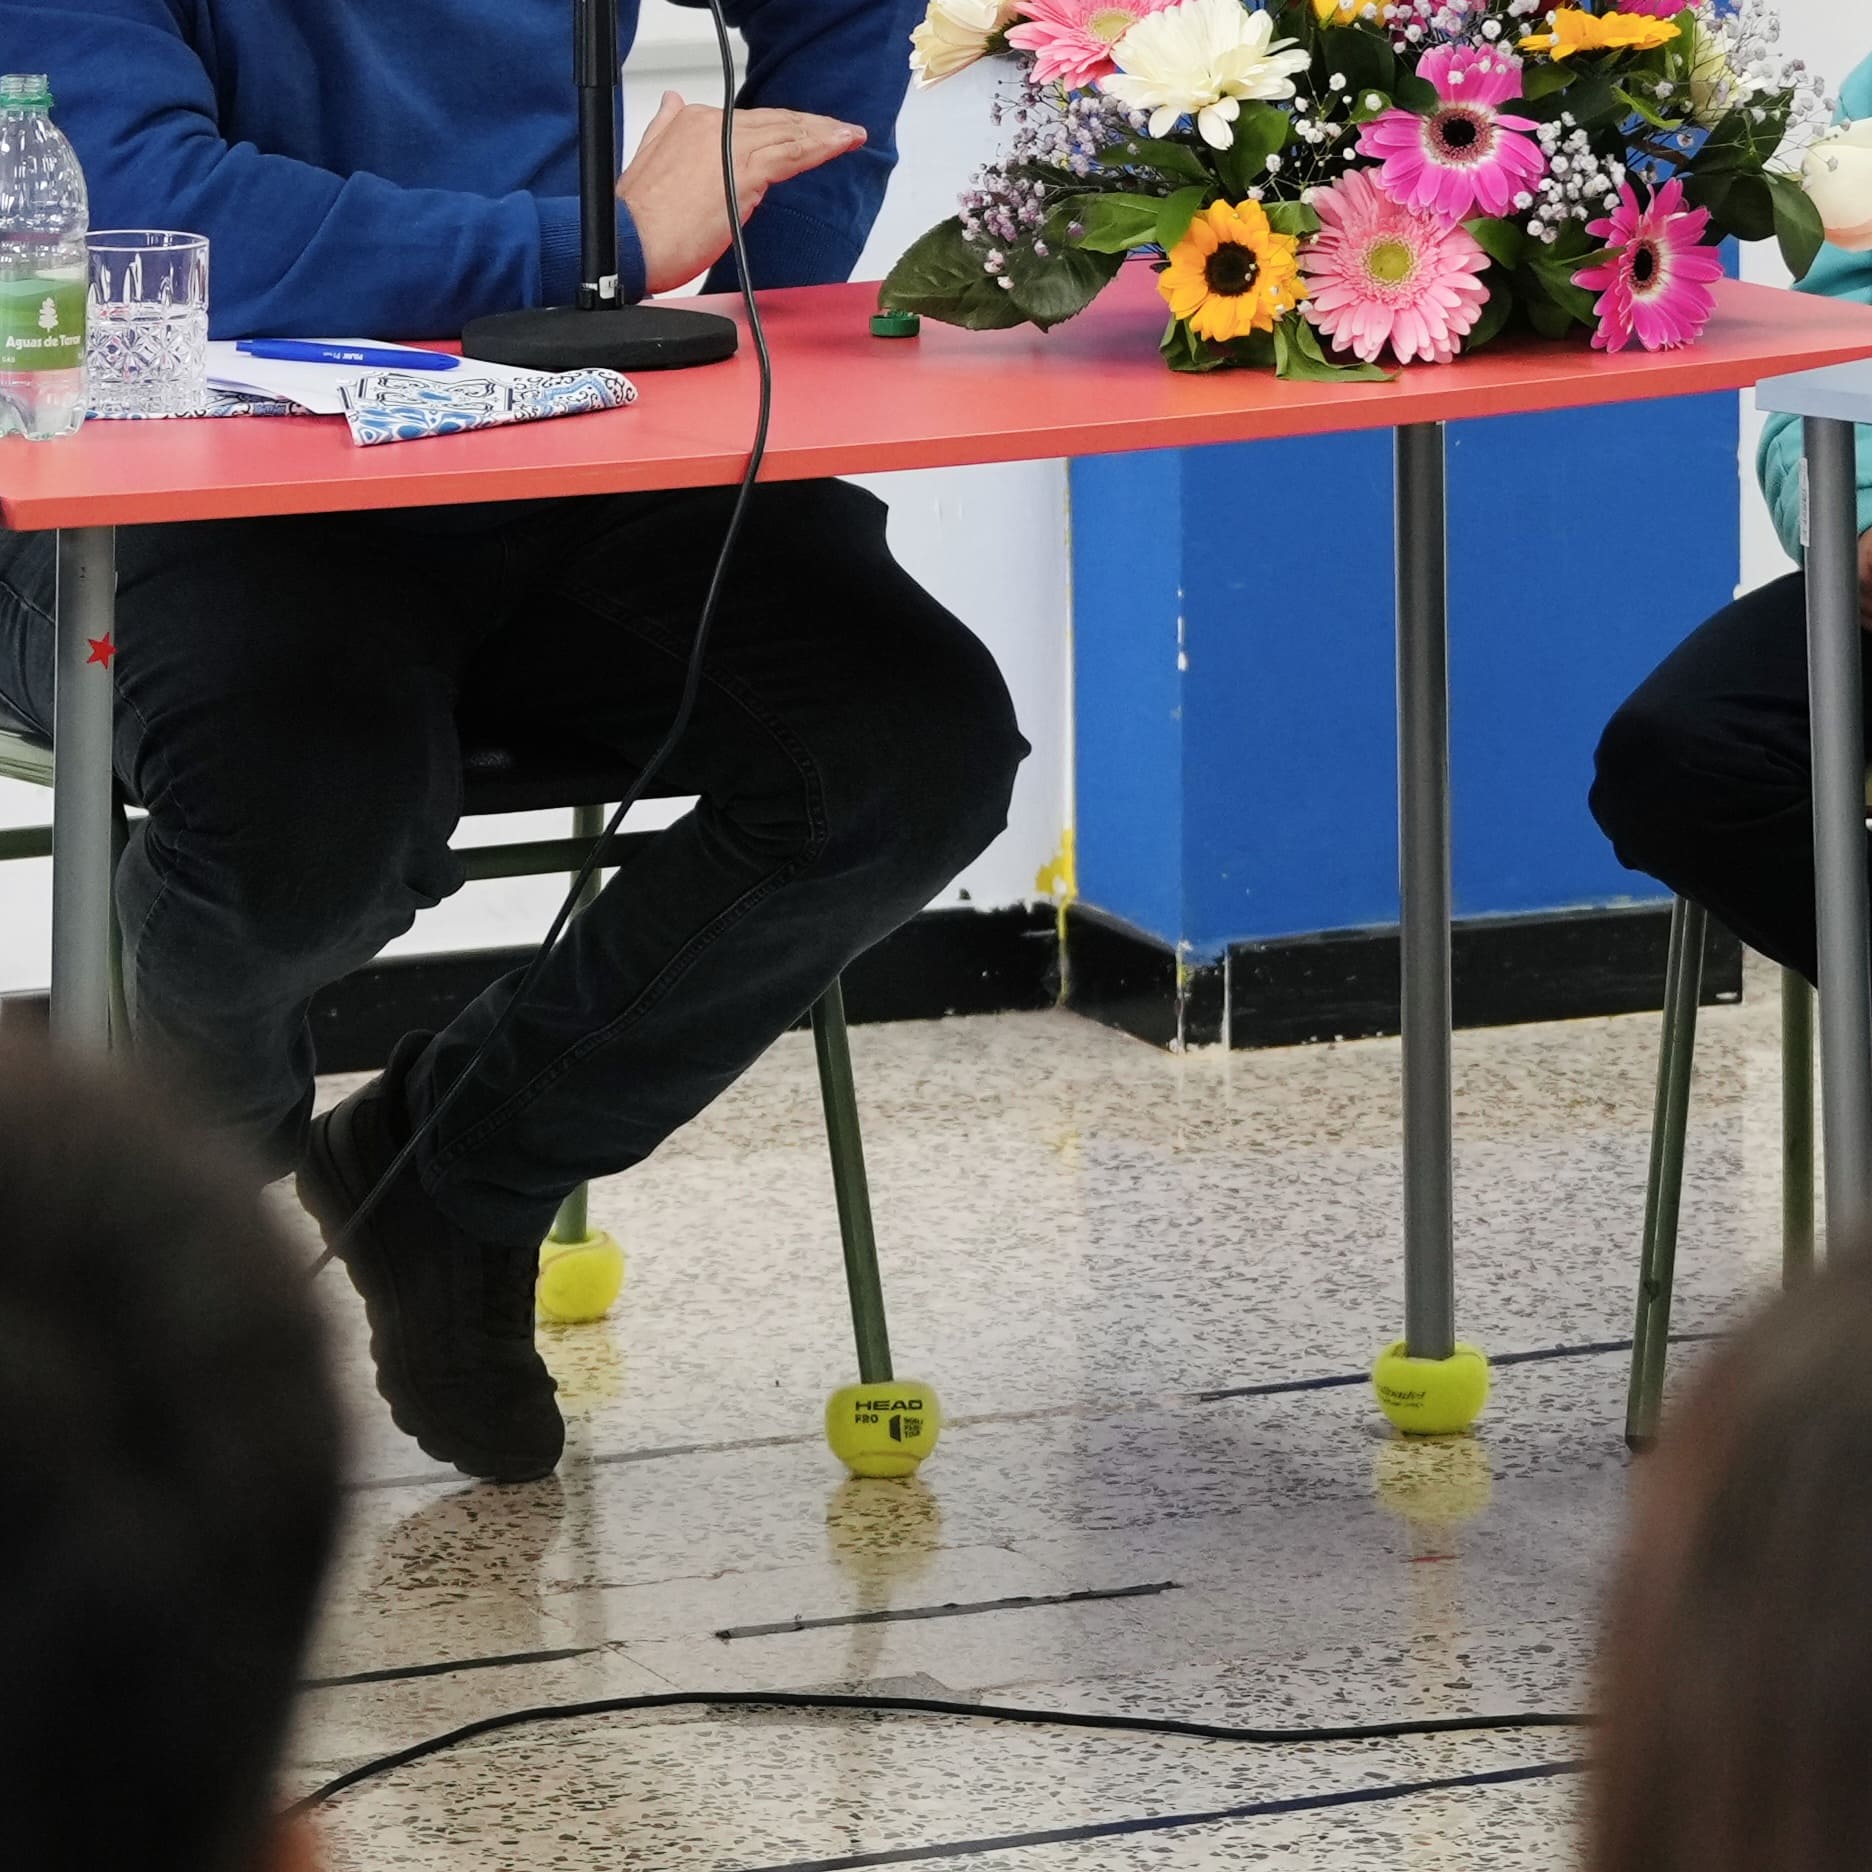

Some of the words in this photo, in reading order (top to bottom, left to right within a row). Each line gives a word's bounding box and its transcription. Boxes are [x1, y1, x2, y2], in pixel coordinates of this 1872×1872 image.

[6, 335, 42, 350] Aguas
[43, 336, 59, 347] de
[855, 1399, 923, 1411] HEAD
[855, 1414, 879, 1424] PRO
